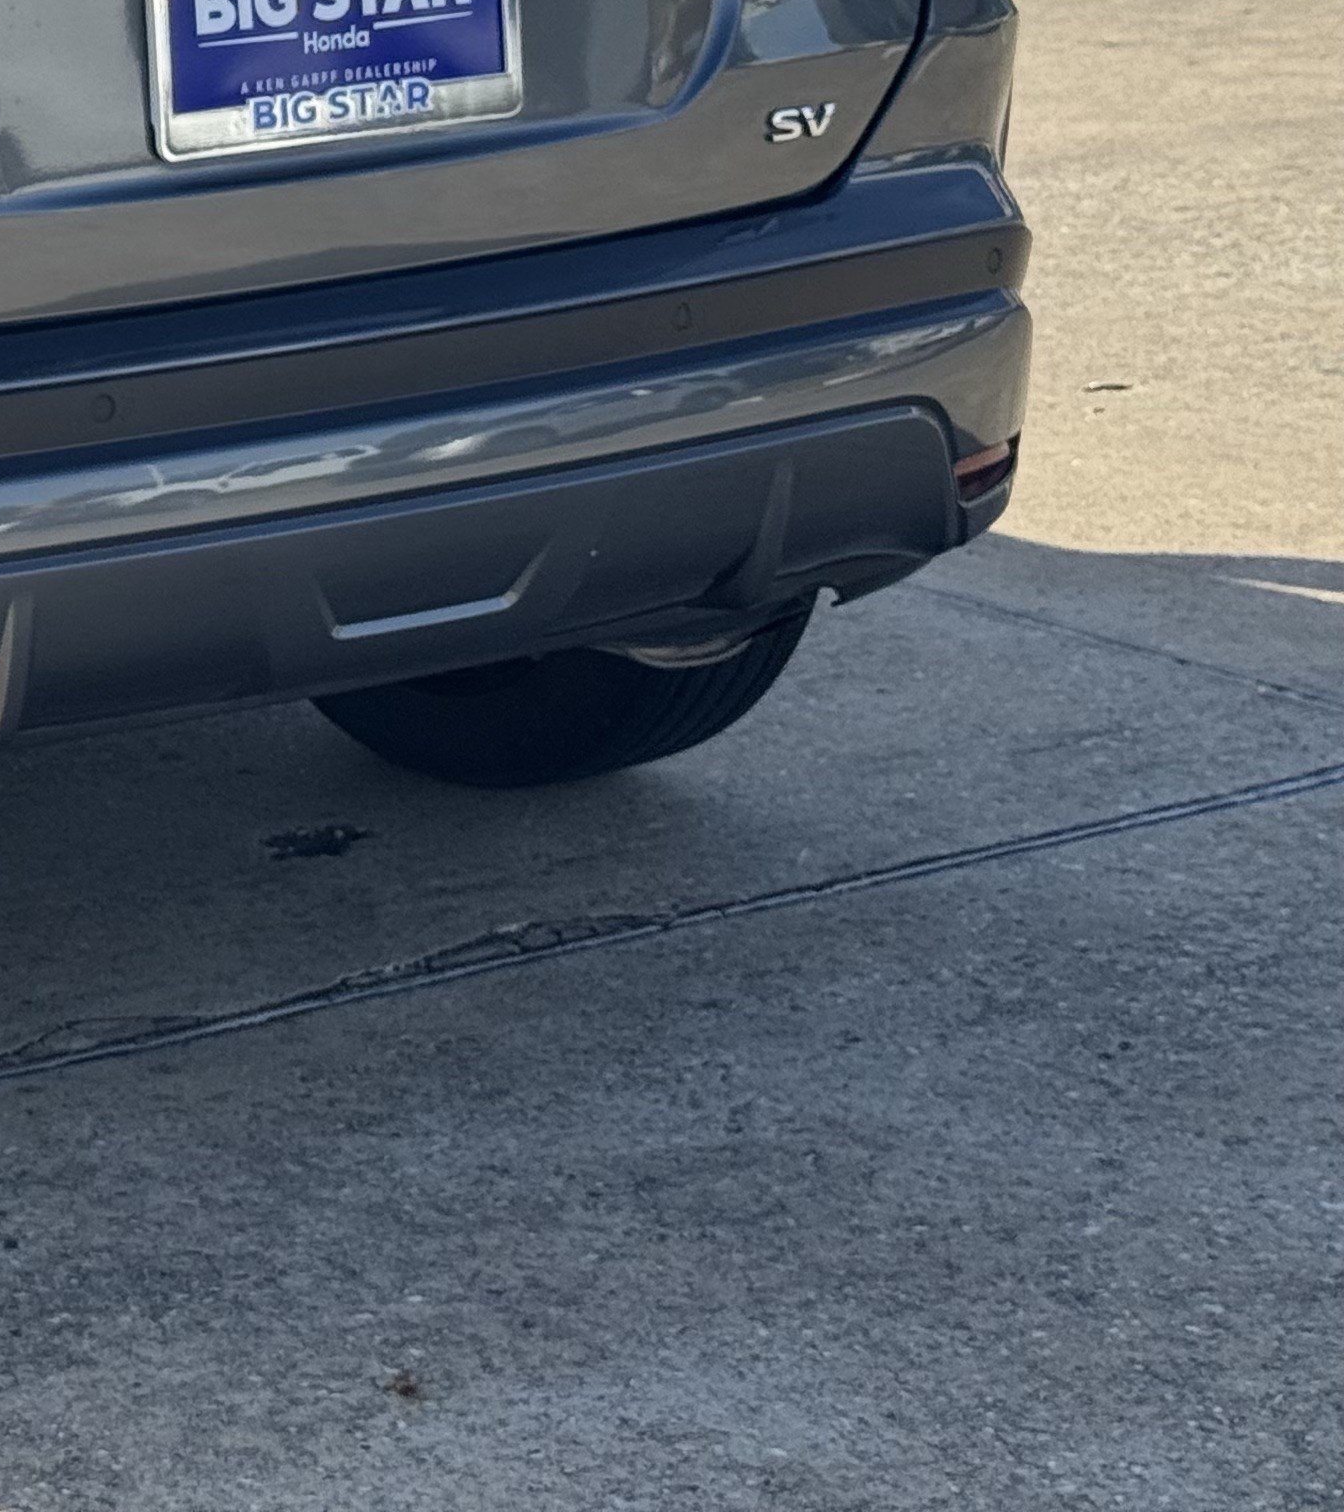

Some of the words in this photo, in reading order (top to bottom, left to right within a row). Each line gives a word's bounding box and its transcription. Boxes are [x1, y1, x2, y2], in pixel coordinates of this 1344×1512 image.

[302, 24, 372, 55] Honda
[344, 58, 438, 82] DEALERSHIP
[251, 94, 318, 131] BIG
[327, 79, 432, 121] STAR
[767, 100, 836, 144] SV
